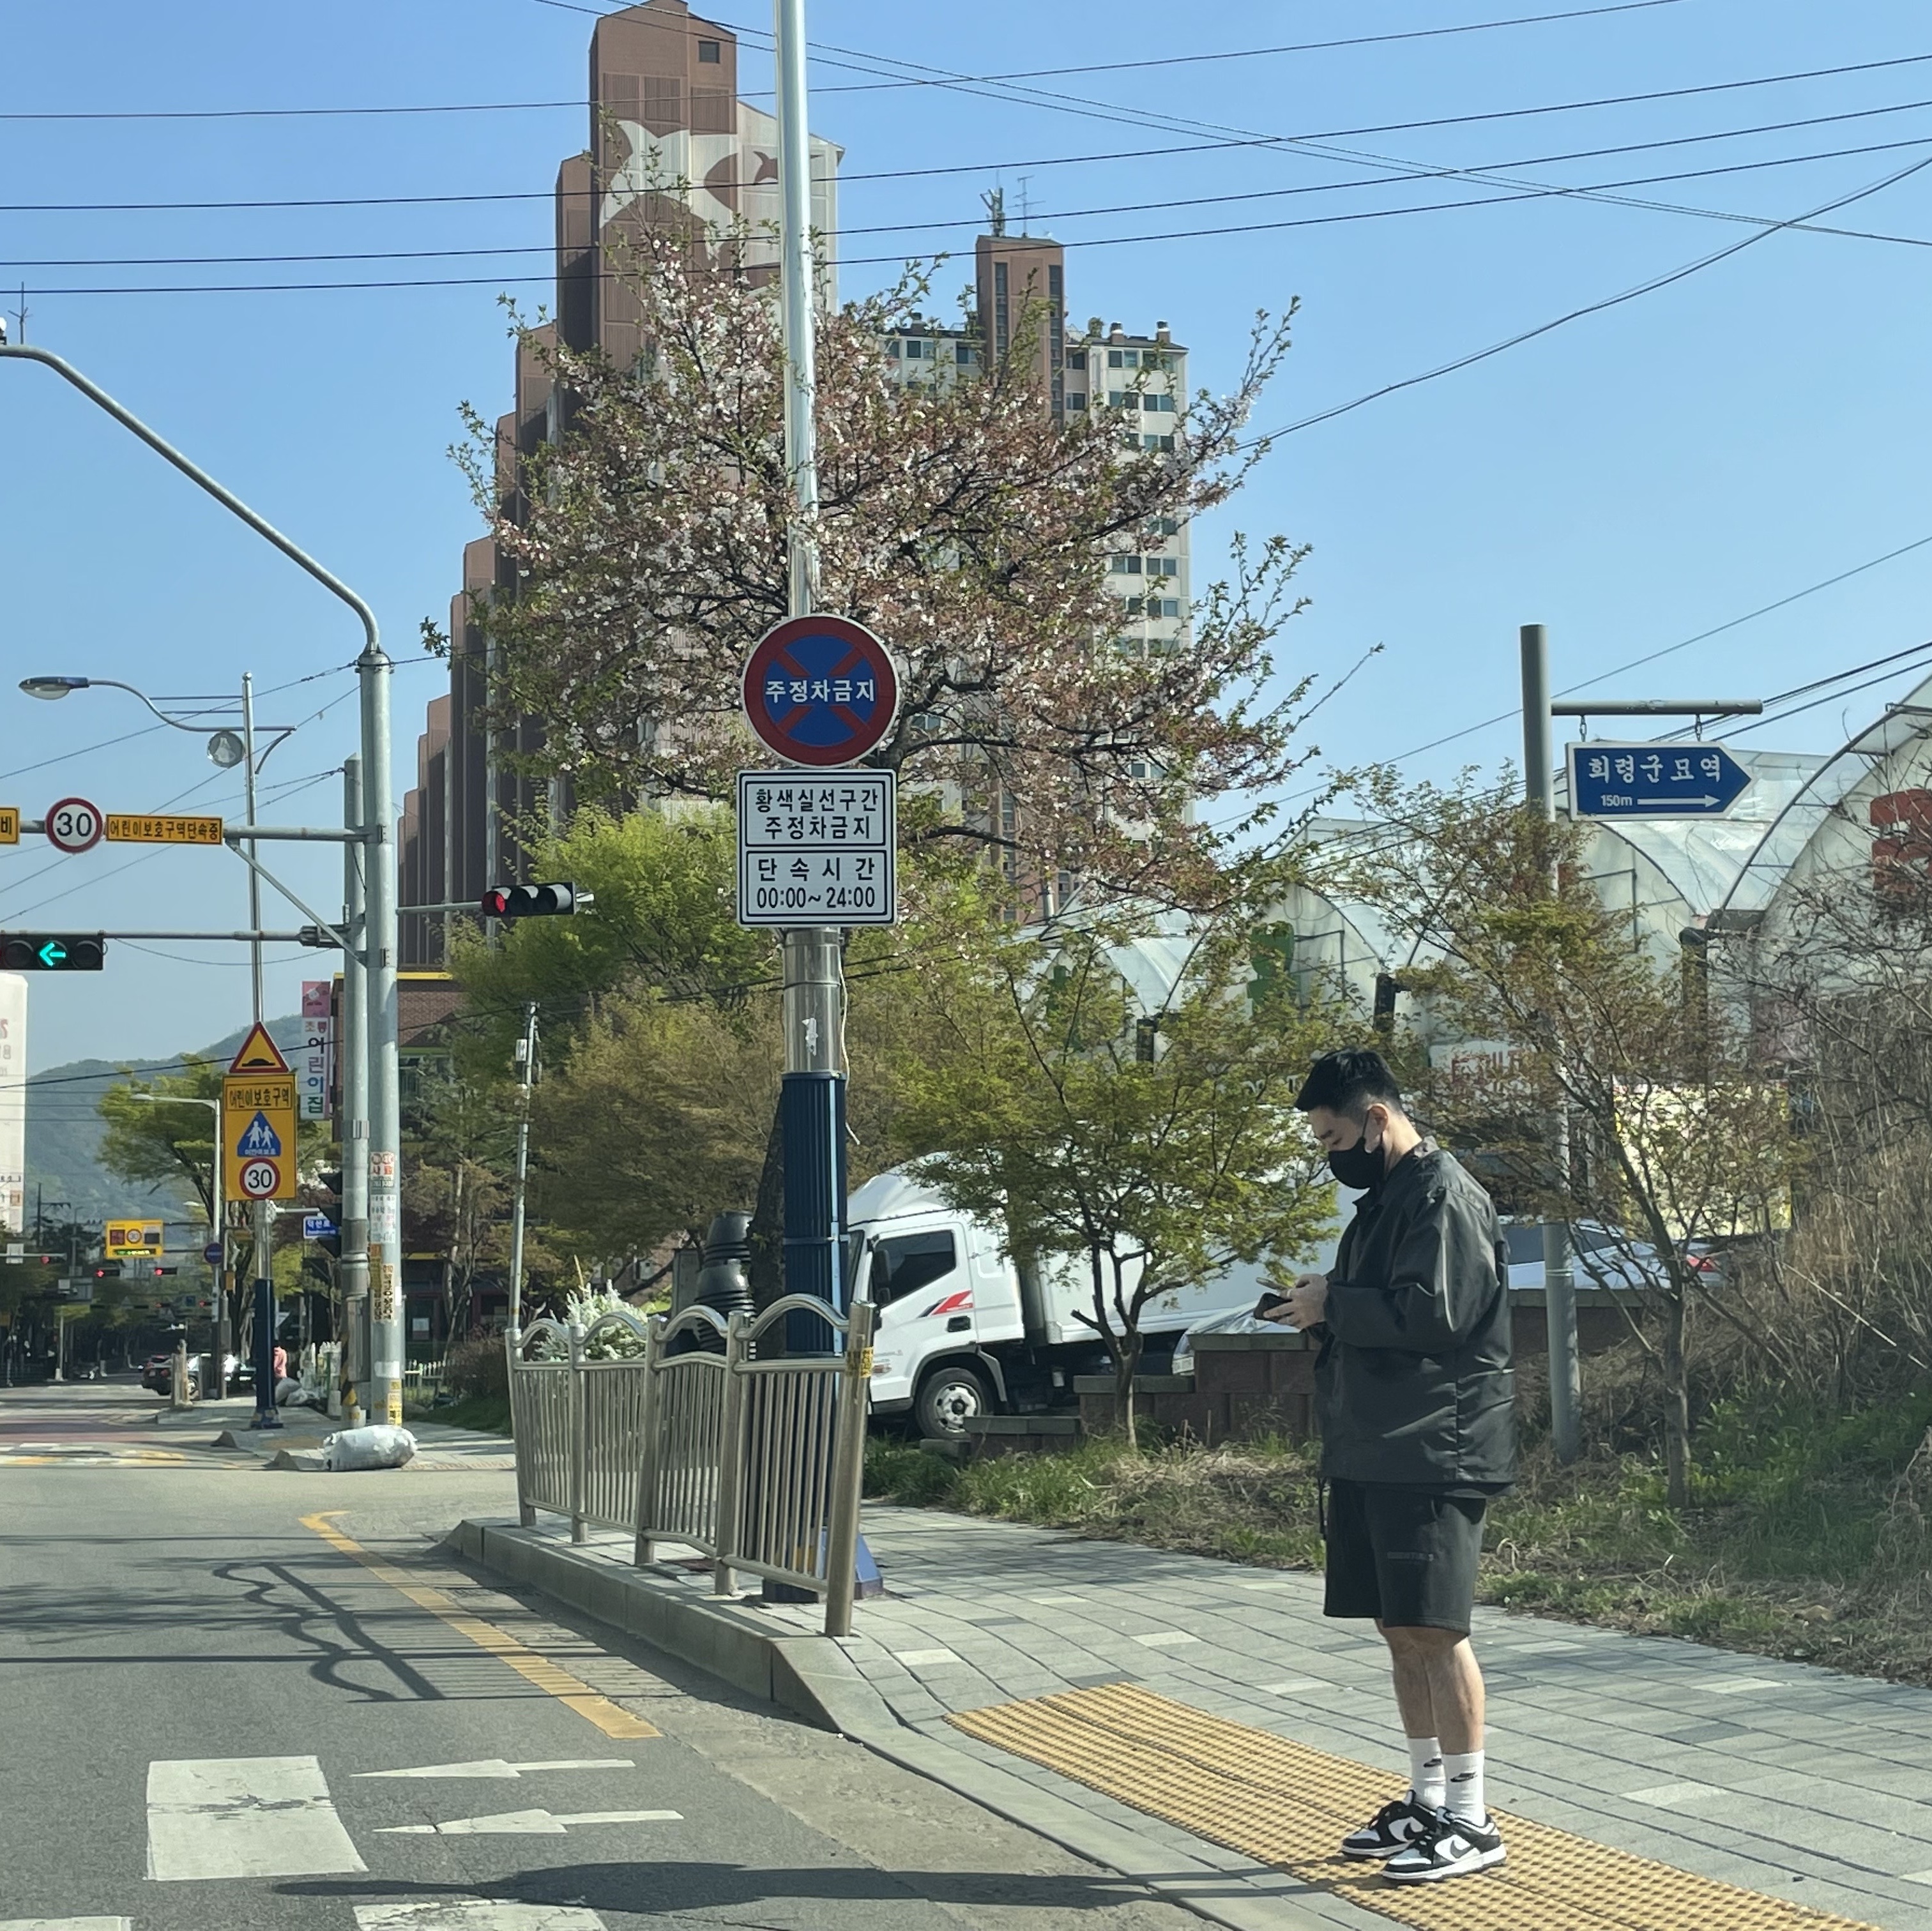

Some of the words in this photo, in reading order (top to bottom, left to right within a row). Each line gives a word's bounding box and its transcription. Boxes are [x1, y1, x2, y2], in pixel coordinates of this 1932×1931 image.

[765, 678, 875, 704] 주정차금지
[755, 788, 878, 813] 황색실선구간
[1600, 794, 1633, 806] 150m
[56, 812, 93, 837] 30
[109, 819, 219, 840] 어린이보호구역단속중
[764, 815, 870, 840] 주정차금지
[307, 1036, 324, 1114] 어린이집
[229, 1087, 289, 1108] 어린이보호구역
[248, 1169, 272, 1188] 30
